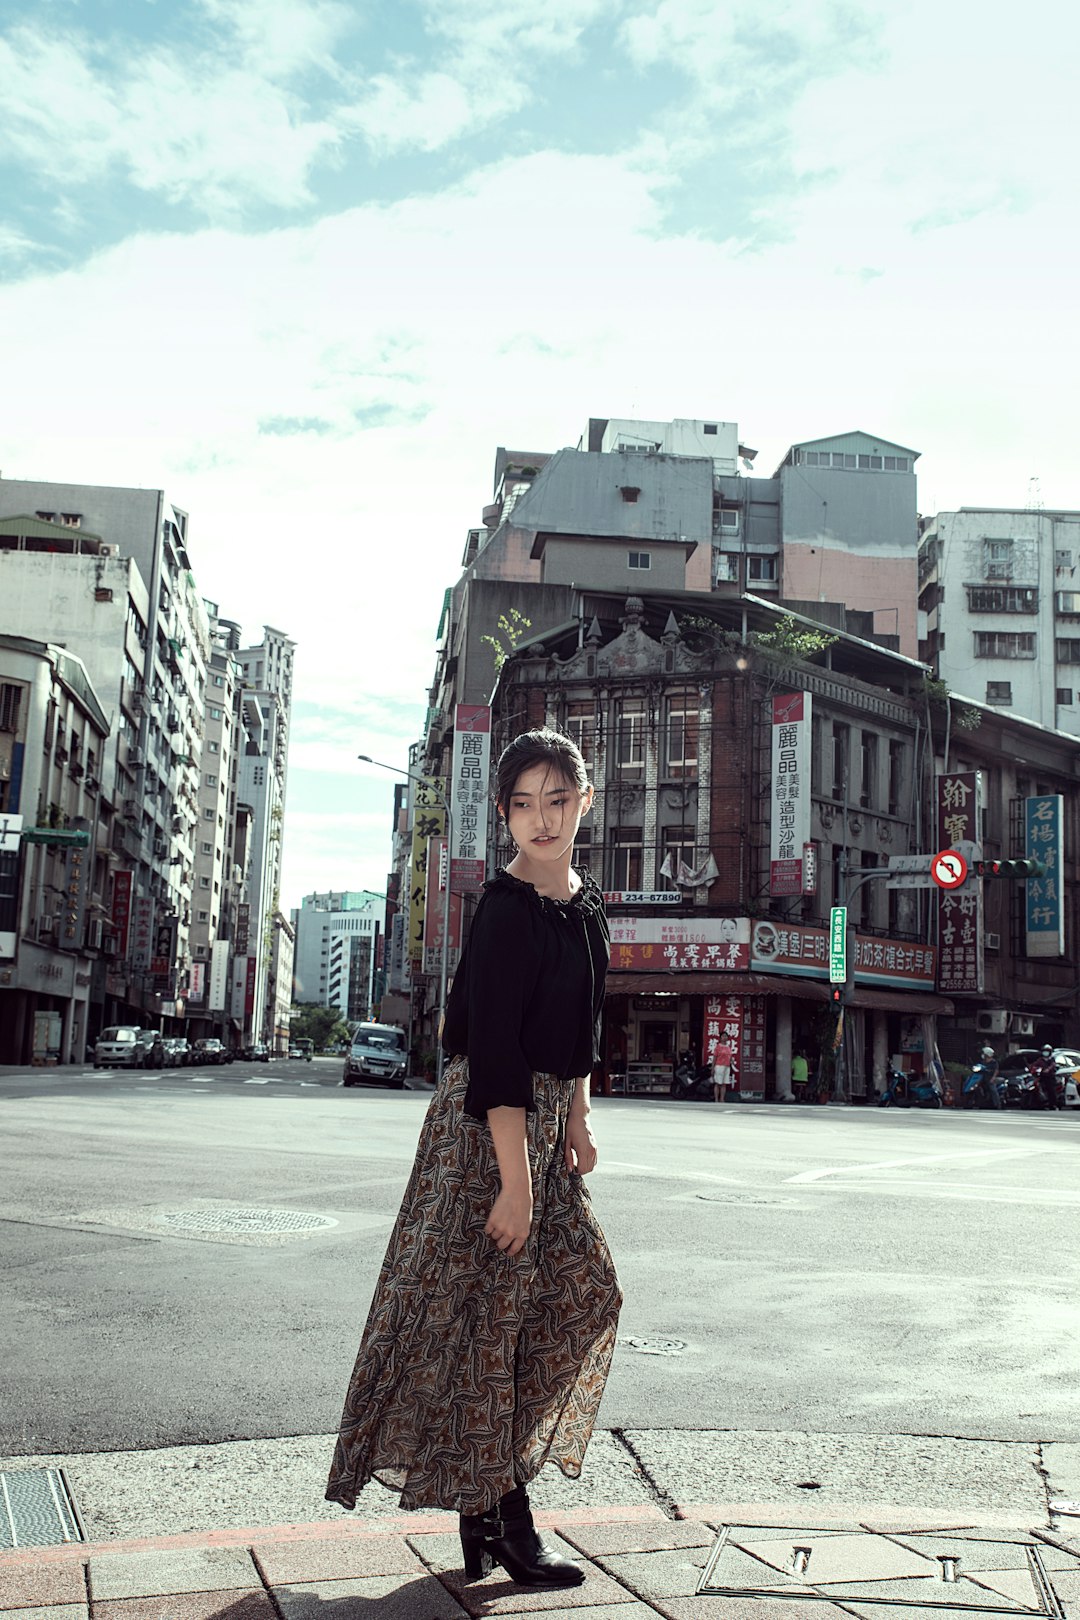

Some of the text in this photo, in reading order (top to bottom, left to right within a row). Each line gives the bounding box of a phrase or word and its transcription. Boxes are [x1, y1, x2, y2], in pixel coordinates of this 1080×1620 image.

[625, 894, 681, 902] 234-67890
[609, 929, 636, 940] 課程
[834, 916, 842, 952] 長安西路
